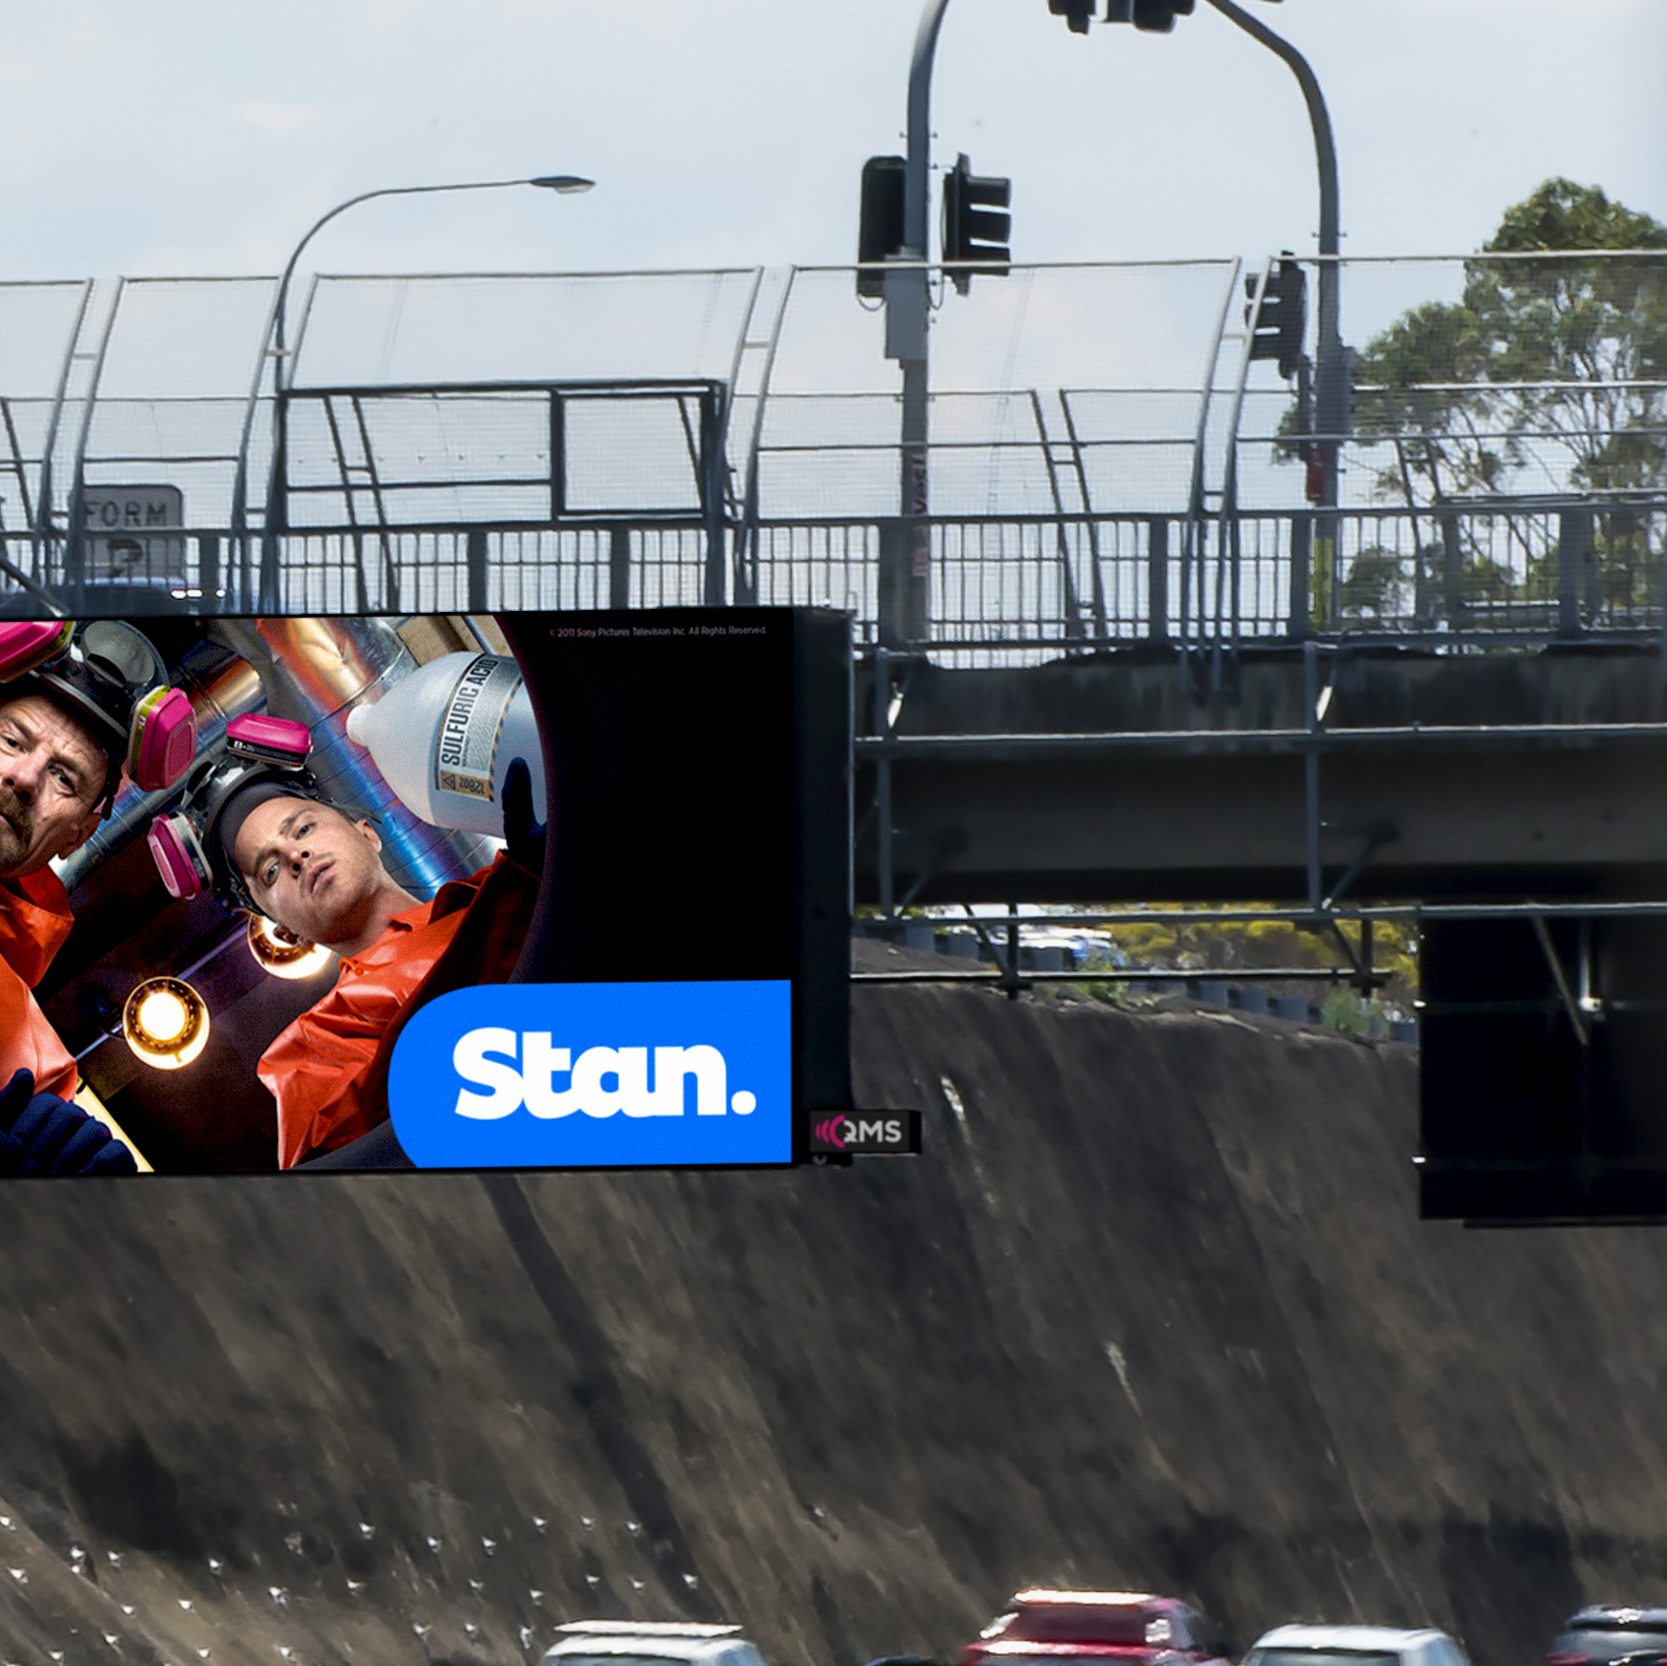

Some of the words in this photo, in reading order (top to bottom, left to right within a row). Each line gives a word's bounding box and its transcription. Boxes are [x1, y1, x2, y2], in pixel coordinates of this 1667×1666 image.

[84, 501, 167, 527] FORM
[576, 627, 597, 639] Sony
[597, 626, 631, 637] Pictures
[632, 626, 671, 637] Television
[688, 625, 700, 636] All
[701, 625, 727, 637] Rights
[441, 687, 480, 767] SULFURIC
[469, 657, 499, 688] ACID
[452, 1026, 758, 1121] Stan.
[829, 1115, 903, 1148] QMS
